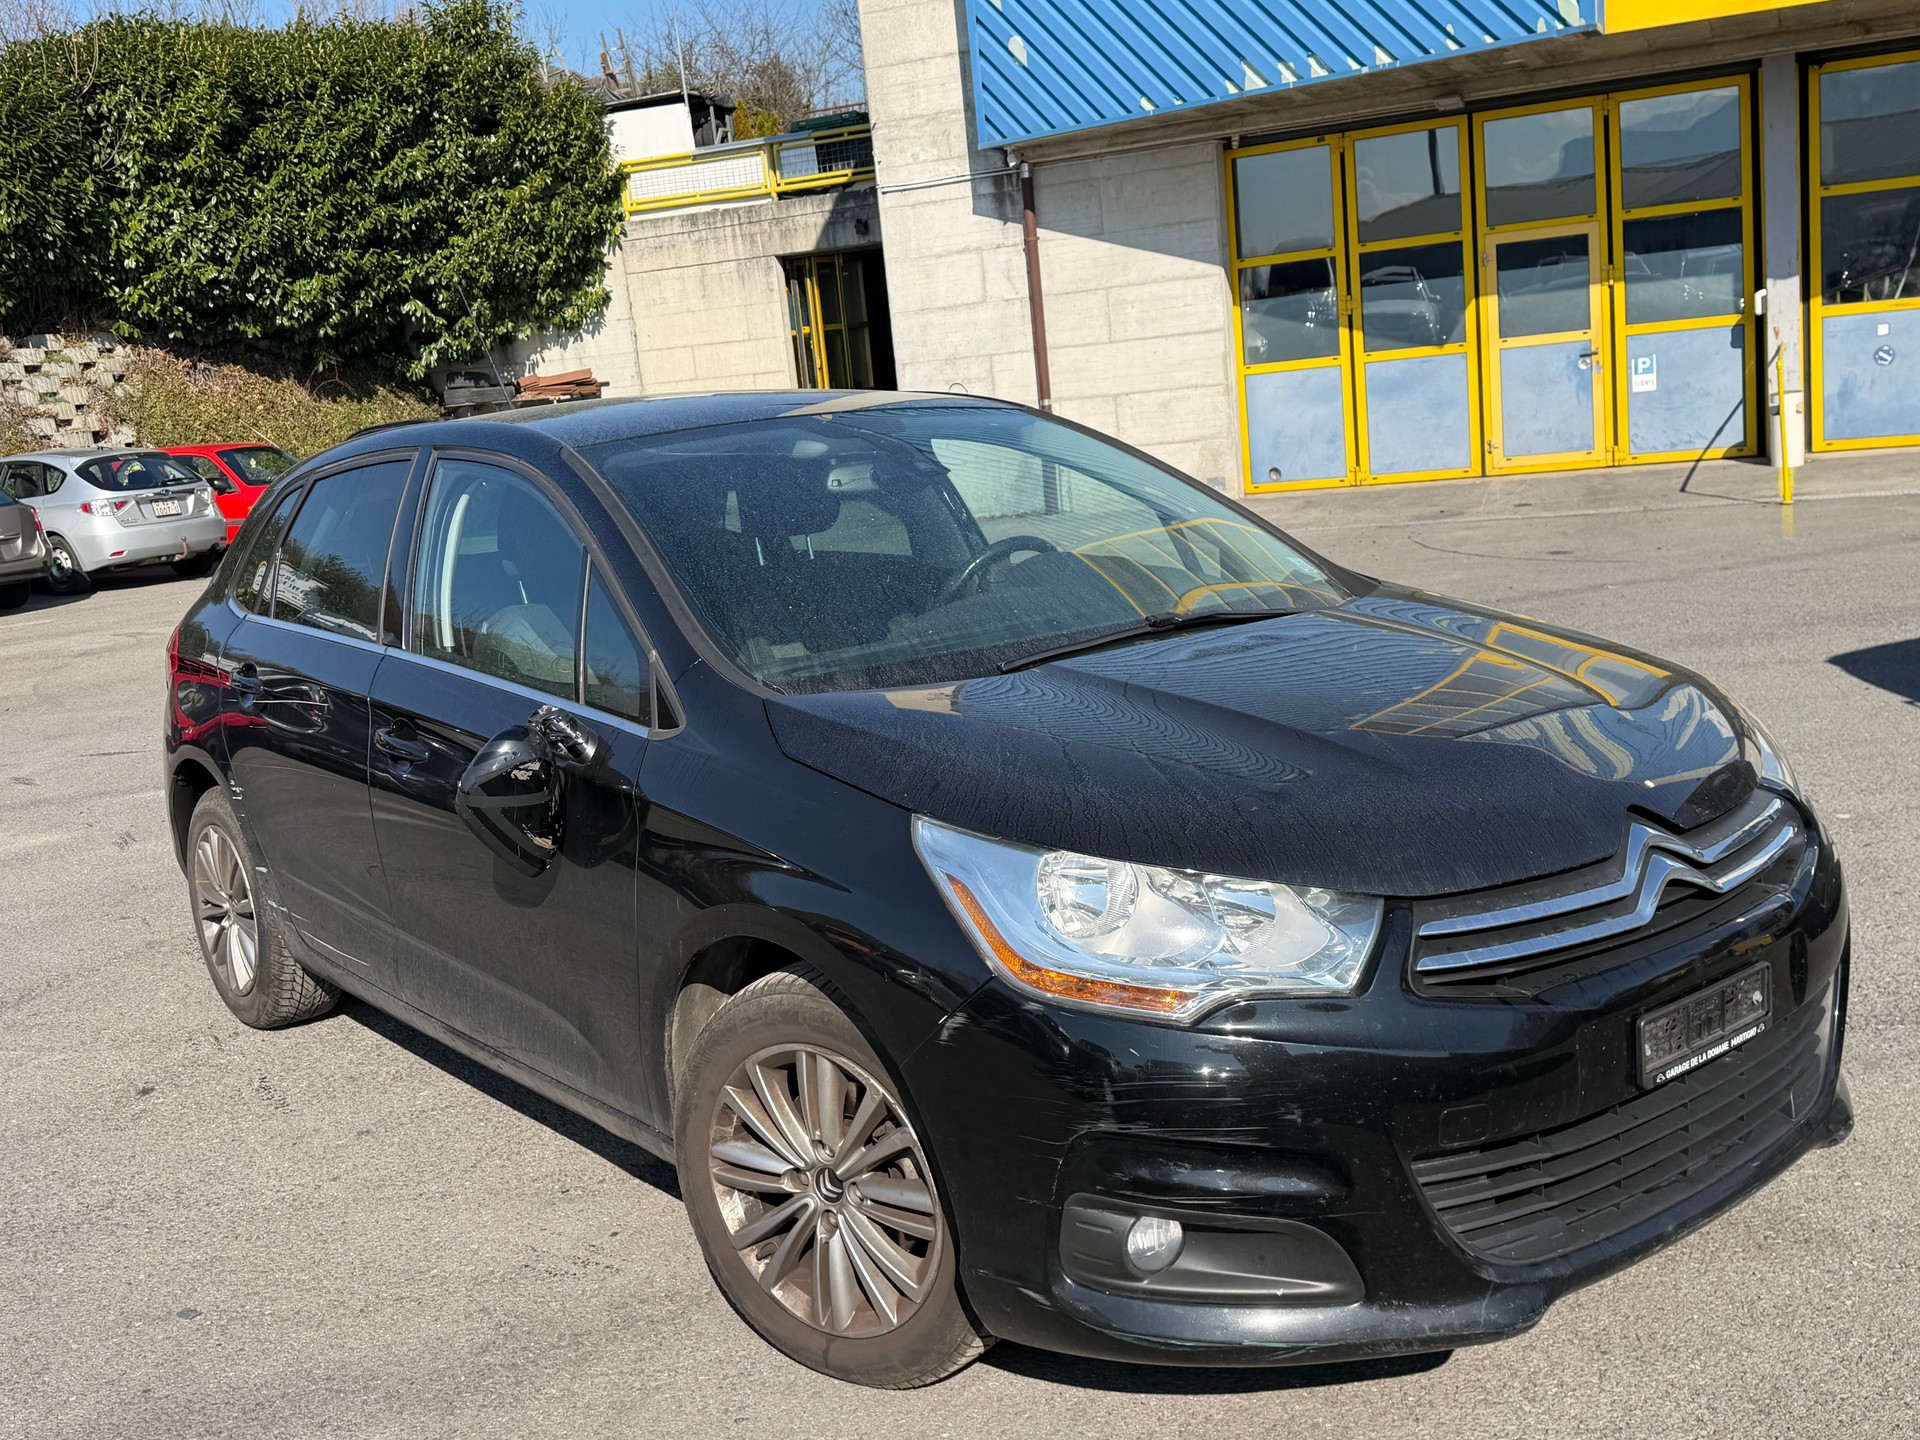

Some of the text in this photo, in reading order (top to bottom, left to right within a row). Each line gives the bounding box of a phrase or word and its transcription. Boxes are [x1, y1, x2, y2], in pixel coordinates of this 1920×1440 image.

[1638, 357, 1651, 374] P
[1665, 1026, 1758, 1079] GARAGE DE LA DOUANE MARTIGNY
